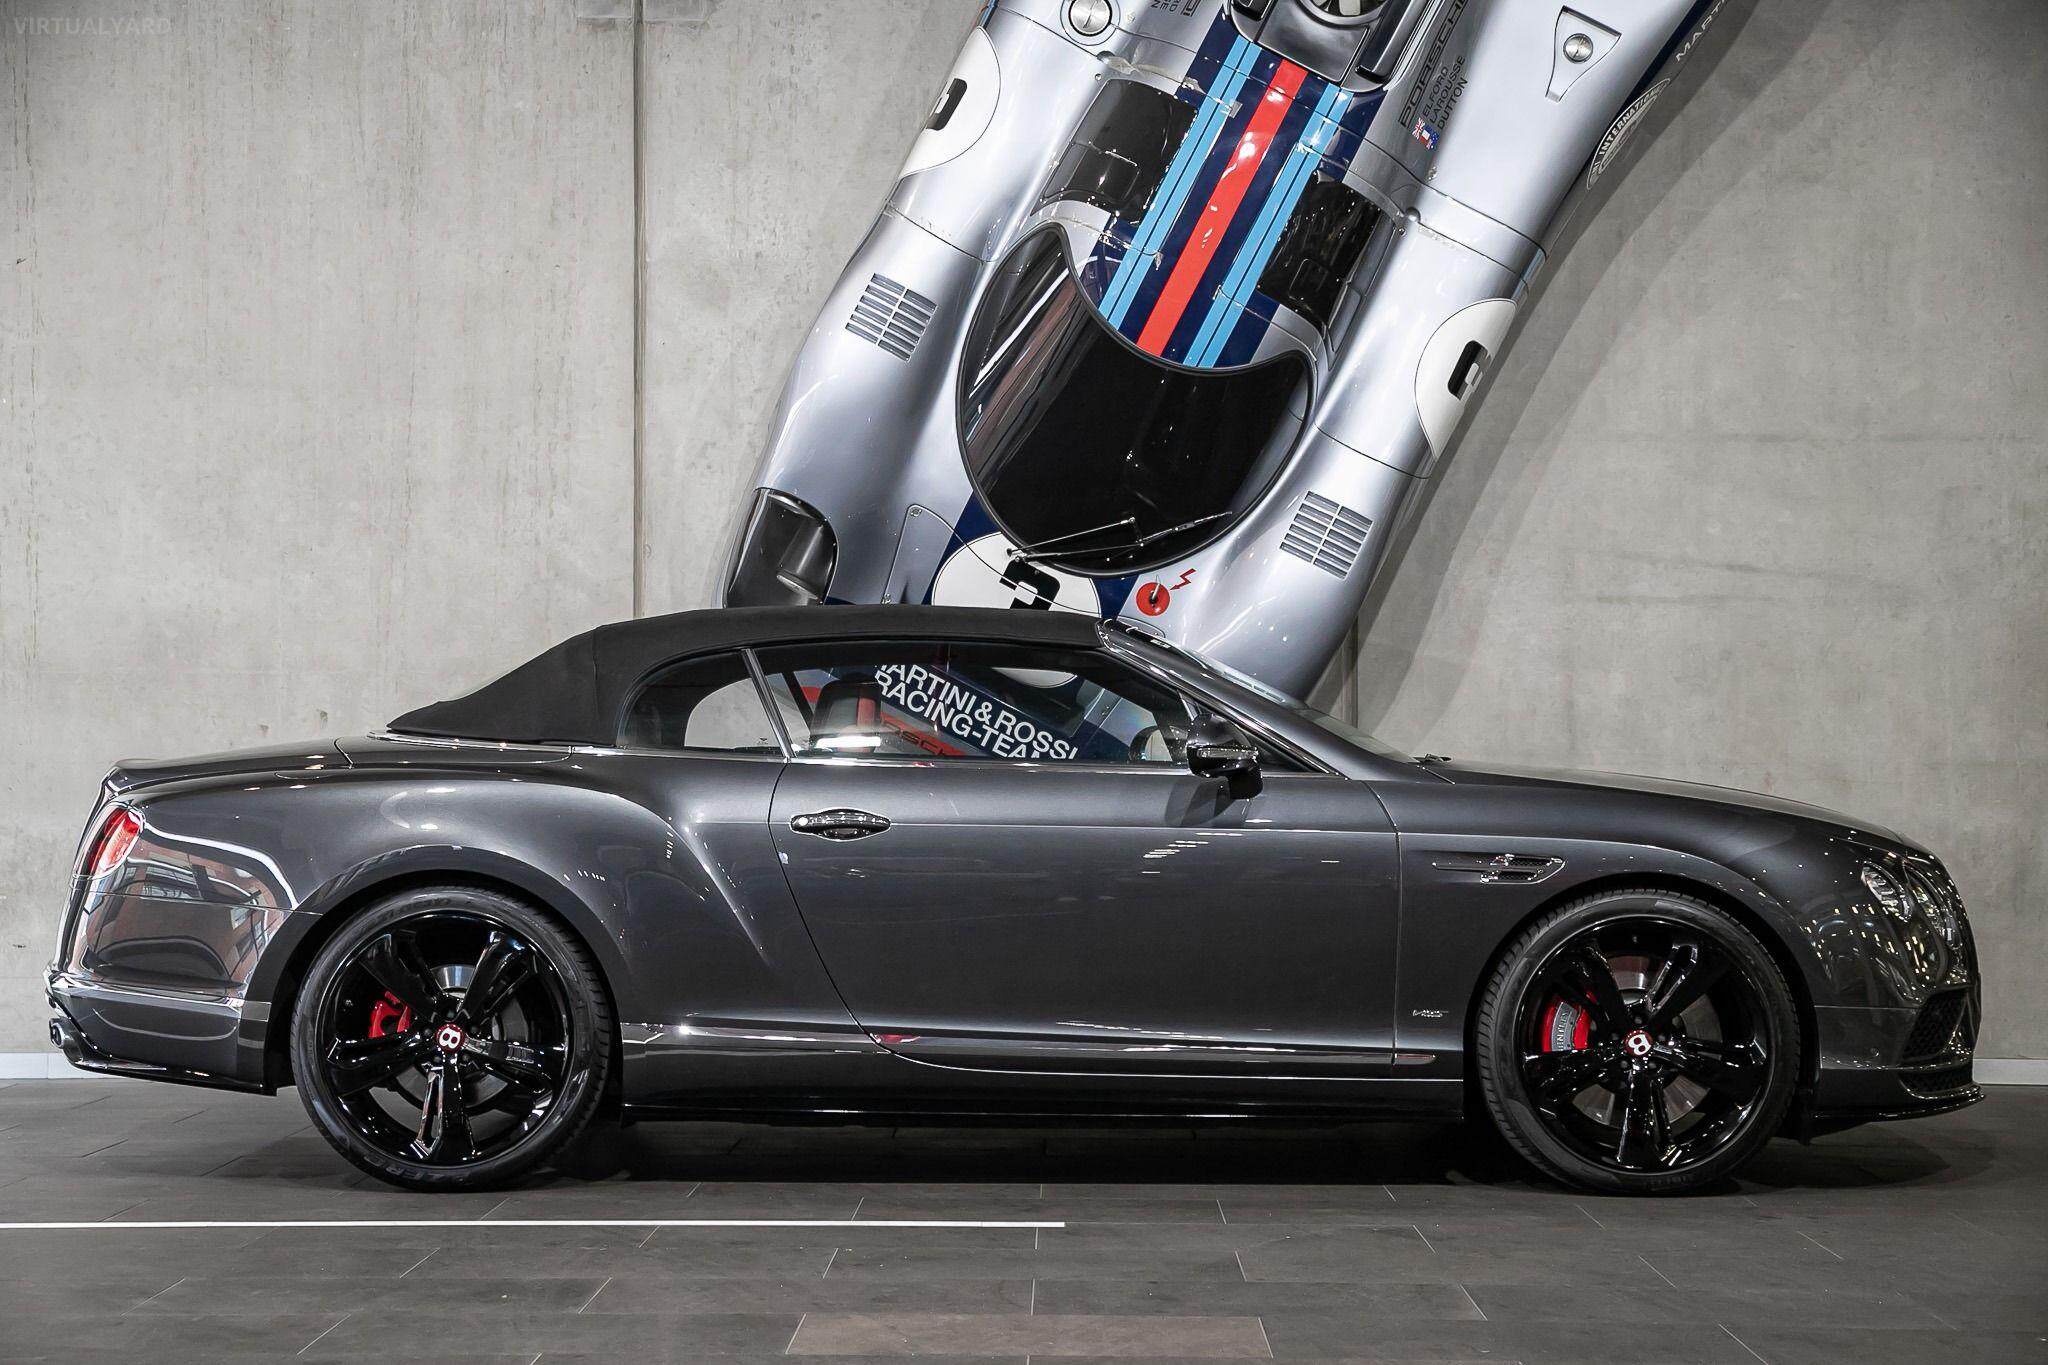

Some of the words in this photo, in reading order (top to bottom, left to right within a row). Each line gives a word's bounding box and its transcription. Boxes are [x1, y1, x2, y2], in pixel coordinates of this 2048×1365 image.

[1676, 0, 1725, 61] MART
[1422, 66, 1449, 117] ELFORD
[1430, 55, 1466, 124] LAROUSSE
[1437, 77, 1469, 130] DUTTON
